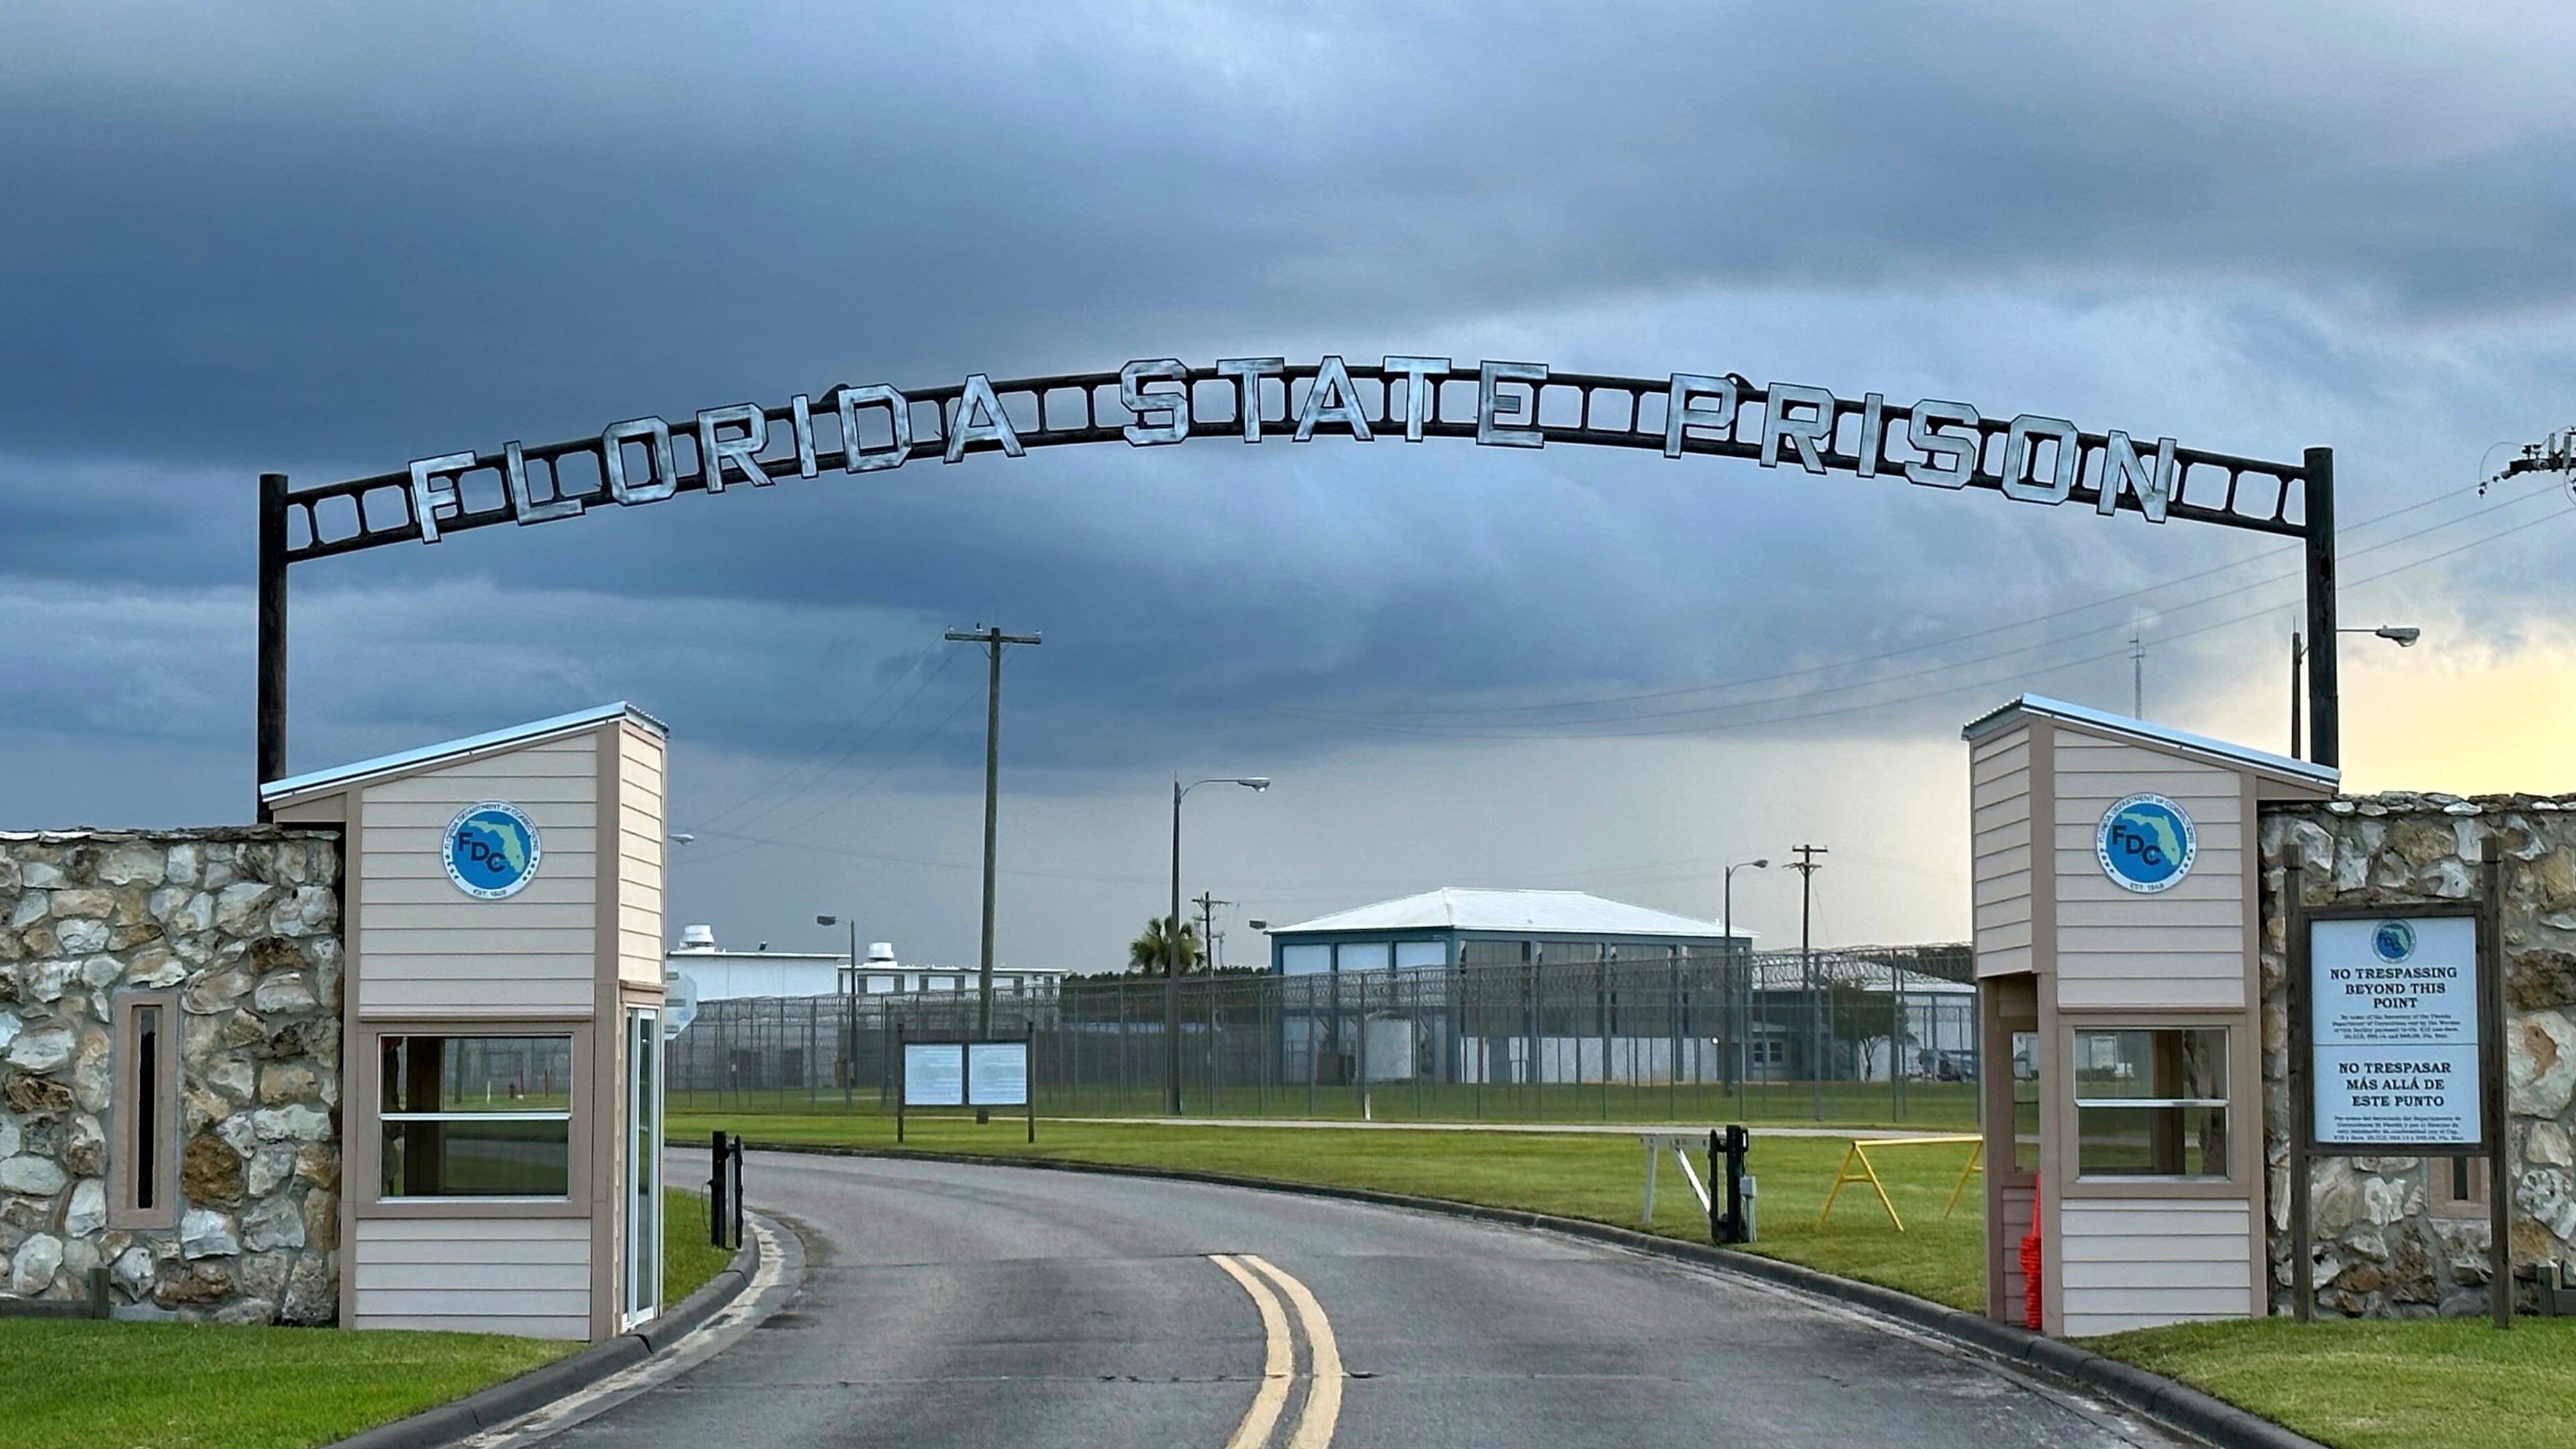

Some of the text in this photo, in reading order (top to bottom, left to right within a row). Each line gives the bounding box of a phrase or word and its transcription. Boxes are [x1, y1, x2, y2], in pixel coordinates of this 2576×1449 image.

[408, 356, 2176, 544] FLORIDA STATE PRISON
[2112, 824, 2161, 866] FDC
[458, 832, 506, 873] FDC
[2330, 967, 2457, 979] NO TRESPASSING
[2345, 983, 2446, 994] BEYOND THIS
[2373, 998, 2418, 1008] POINT
[2339, 1063, 2451, 1073] NO TRESPASAR
[2346, 1077, 2445, 1090] MÁS ALLÁ DE
[2352, 1095, 2444, 1107] ESTE PUNTO
